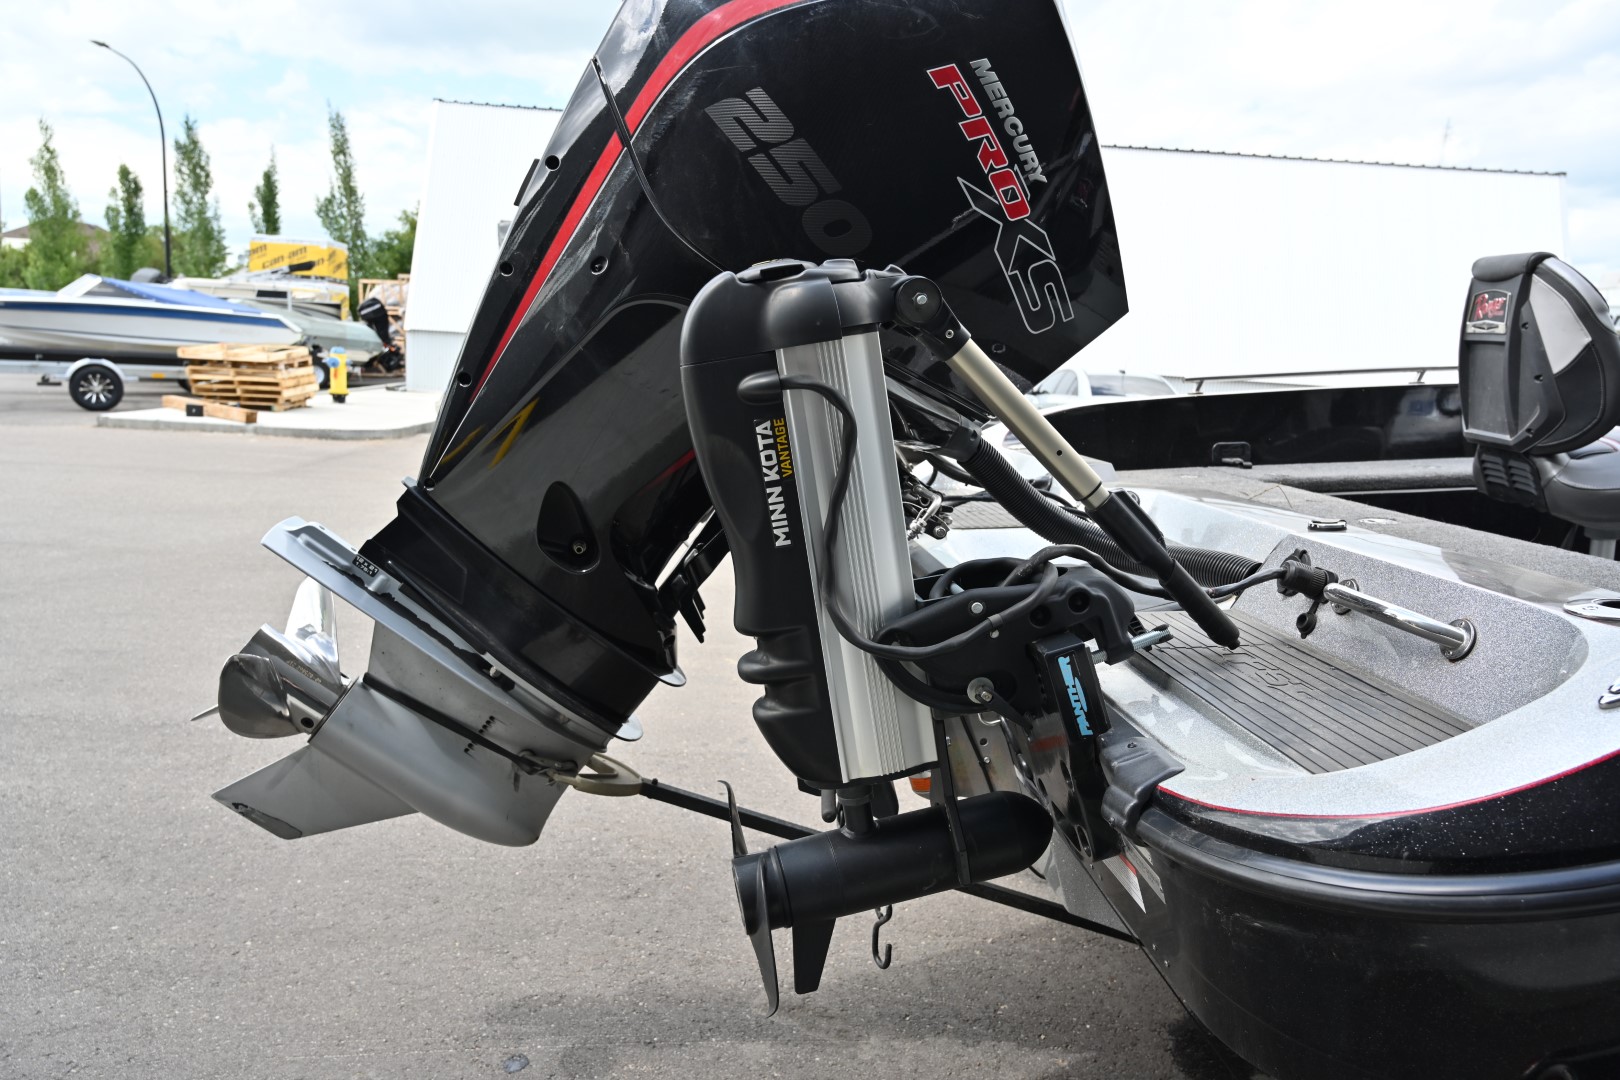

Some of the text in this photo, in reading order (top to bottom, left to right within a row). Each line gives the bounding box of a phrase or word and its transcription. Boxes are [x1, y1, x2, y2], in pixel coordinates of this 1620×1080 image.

[703, 85, 874, 257] 250
[926, 62, 1031, 222] PRO
[969, 57, 1048, 185] MERCURY
[755, 419, 792, 547] MINN KOTA
[773, 417, 794, 478] VANTAGE
[1057, 655, 1094, 736] PANTHER
